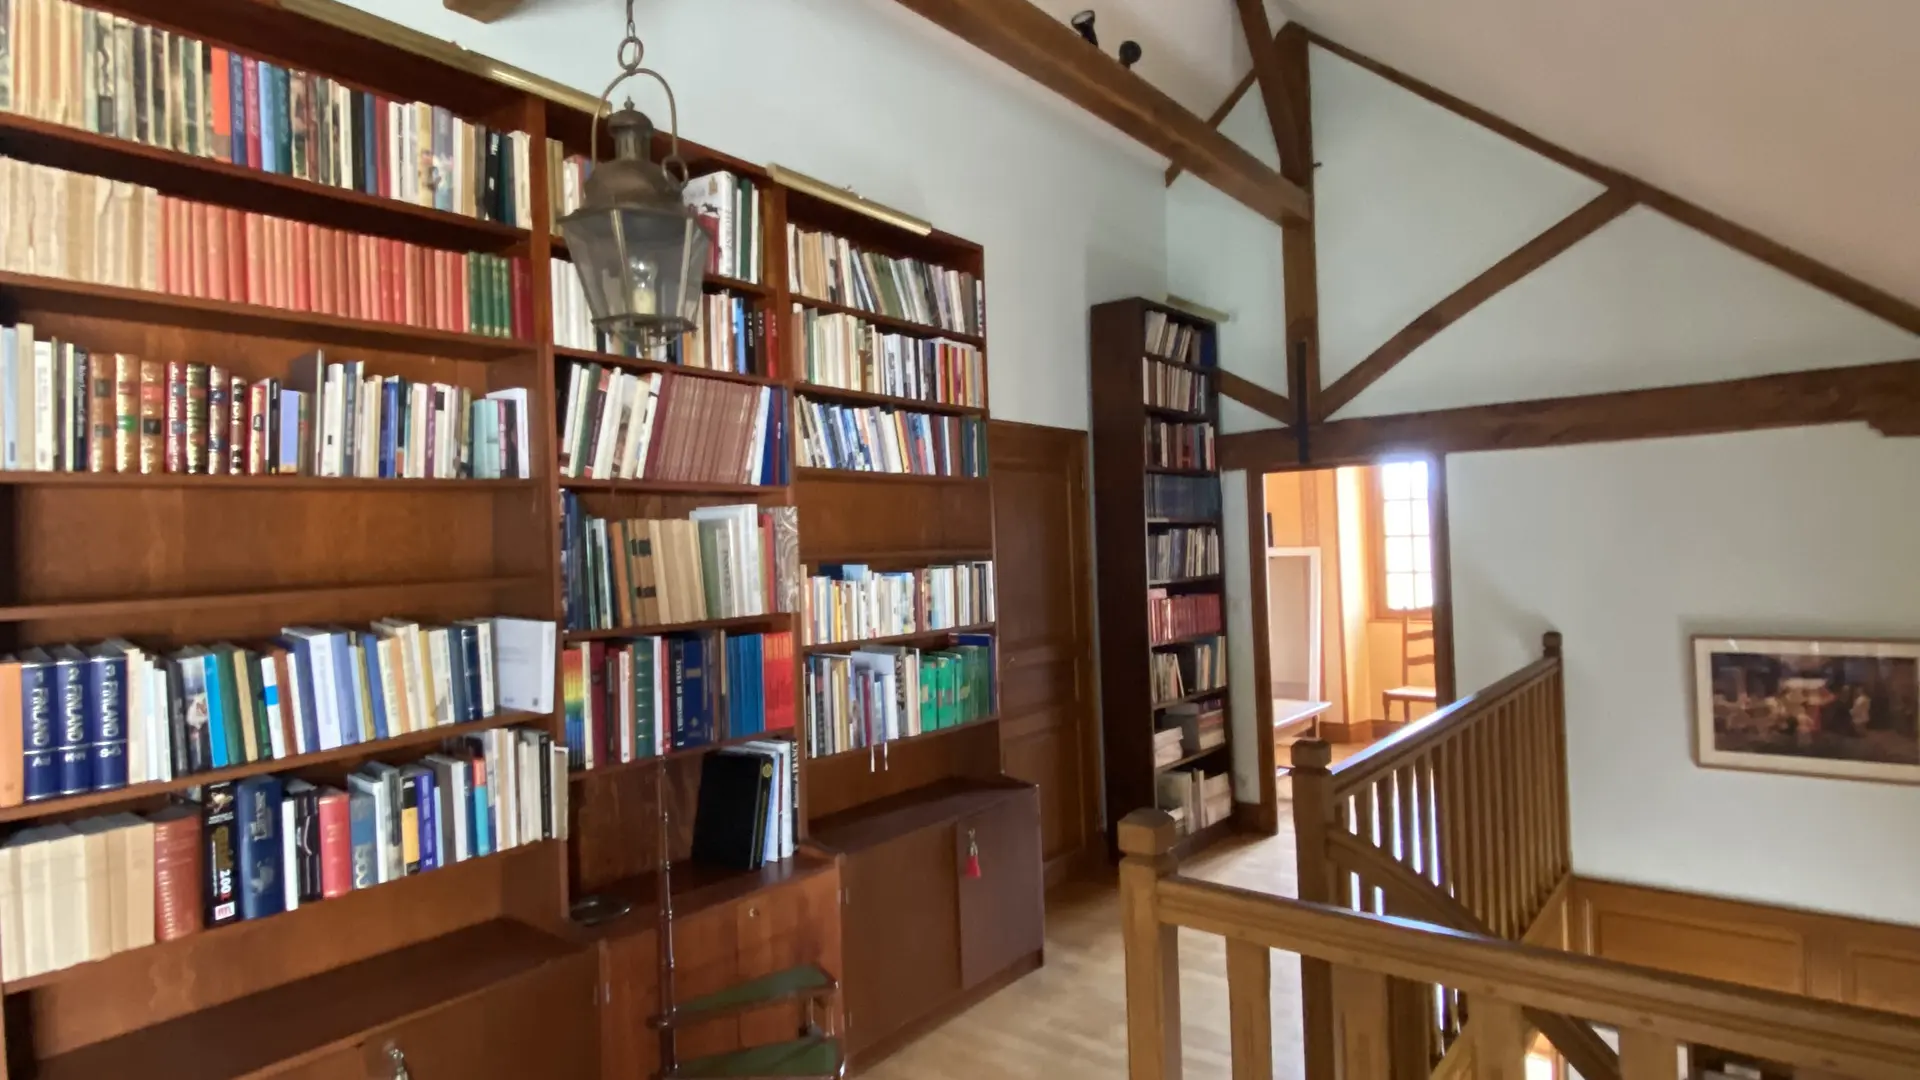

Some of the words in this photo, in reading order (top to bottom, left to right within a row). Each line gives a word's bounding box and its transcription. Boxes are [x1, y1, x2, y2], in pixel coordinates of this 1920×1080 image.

[68, 667, 80, 681] 2
[105, 664, 116, 677] 3
[32, 687, 50, 746] FINLAND
[65, 684, 83, 742] FINLAND
[101, 680, 119, 737] FINLAND
